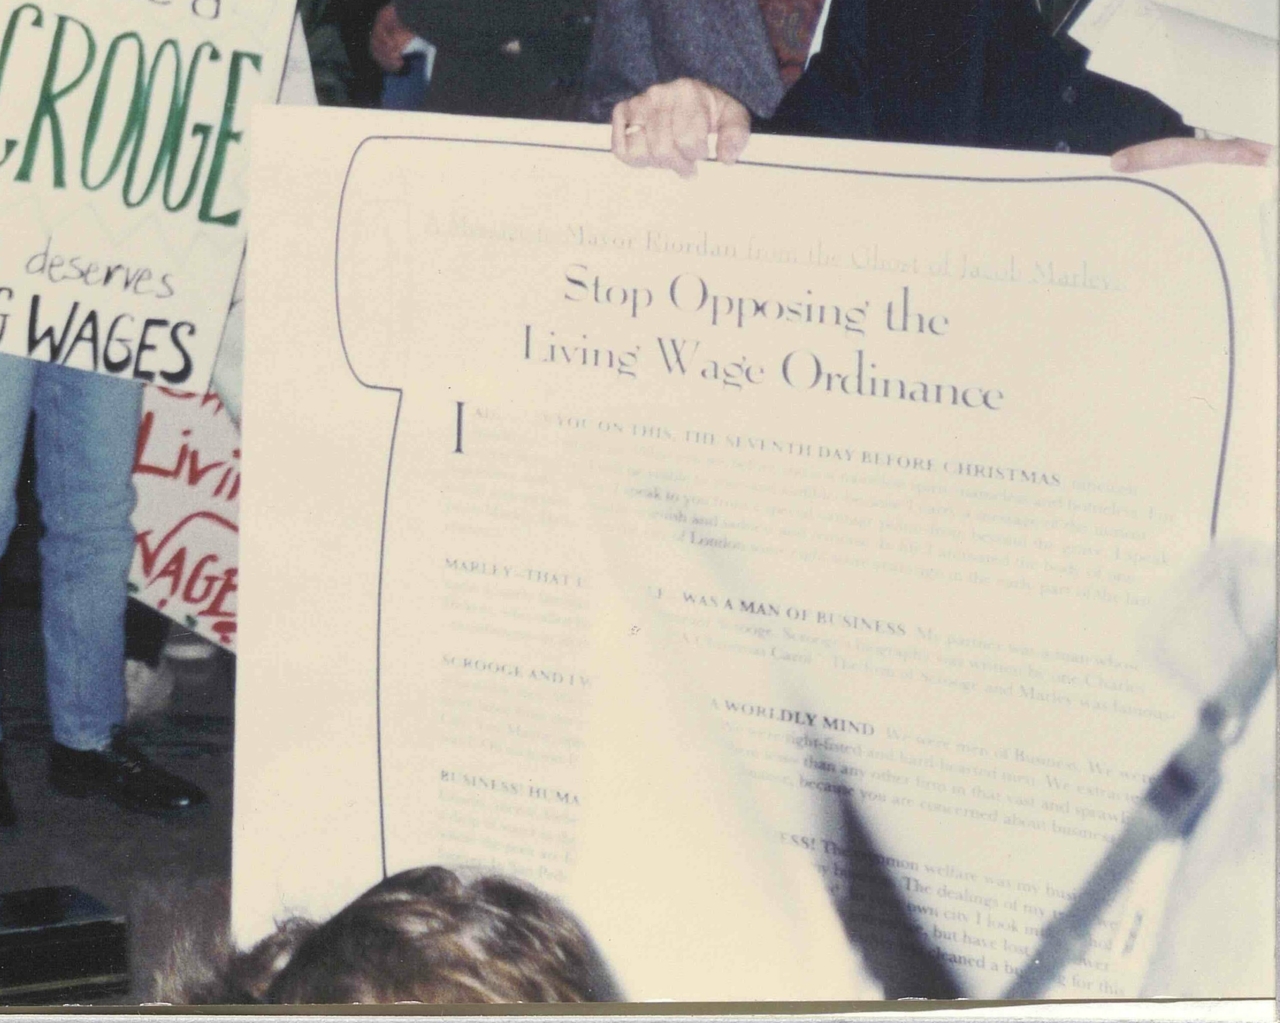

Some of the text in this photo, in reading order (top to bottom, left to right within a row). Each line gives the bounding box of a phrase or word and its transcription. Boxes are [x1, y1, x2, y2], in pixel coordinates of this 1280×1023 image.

[25, 236, 175, 299] deserves
[563, 263, 950, 338] Stop Opposing the
[27, 294, 196, 385] WAGES
[522, 323, 1006, 413] Living Wage Ordinance
[451, 400, 466, 456] I
[597, 420, 624, 434] ON
[684, 429, 716, 445] THE
[726, 434, 812, 458] SEVENTH
[818, 445, 856, 462] DAY
[861, 450, 935, 472] BEFORE
[942, 459, 1062, 486] CHRISTMAS
[683, 590, 718, 607] WAS
[724, 597, 734, 611] A
[739, 599, 780, 617] MAN
[786, 606, 809, 621] OF
[817, 610, 907, 637] BUSINESS
[529, 669, 564, 684] AND
[724, 699, 817, 728] WORLDLY
[823, 716, 875, 736] MIND
[804, 755, 837, 773] than
[900, 876, 931, 894] The
[933, 925, 958, 942] but
